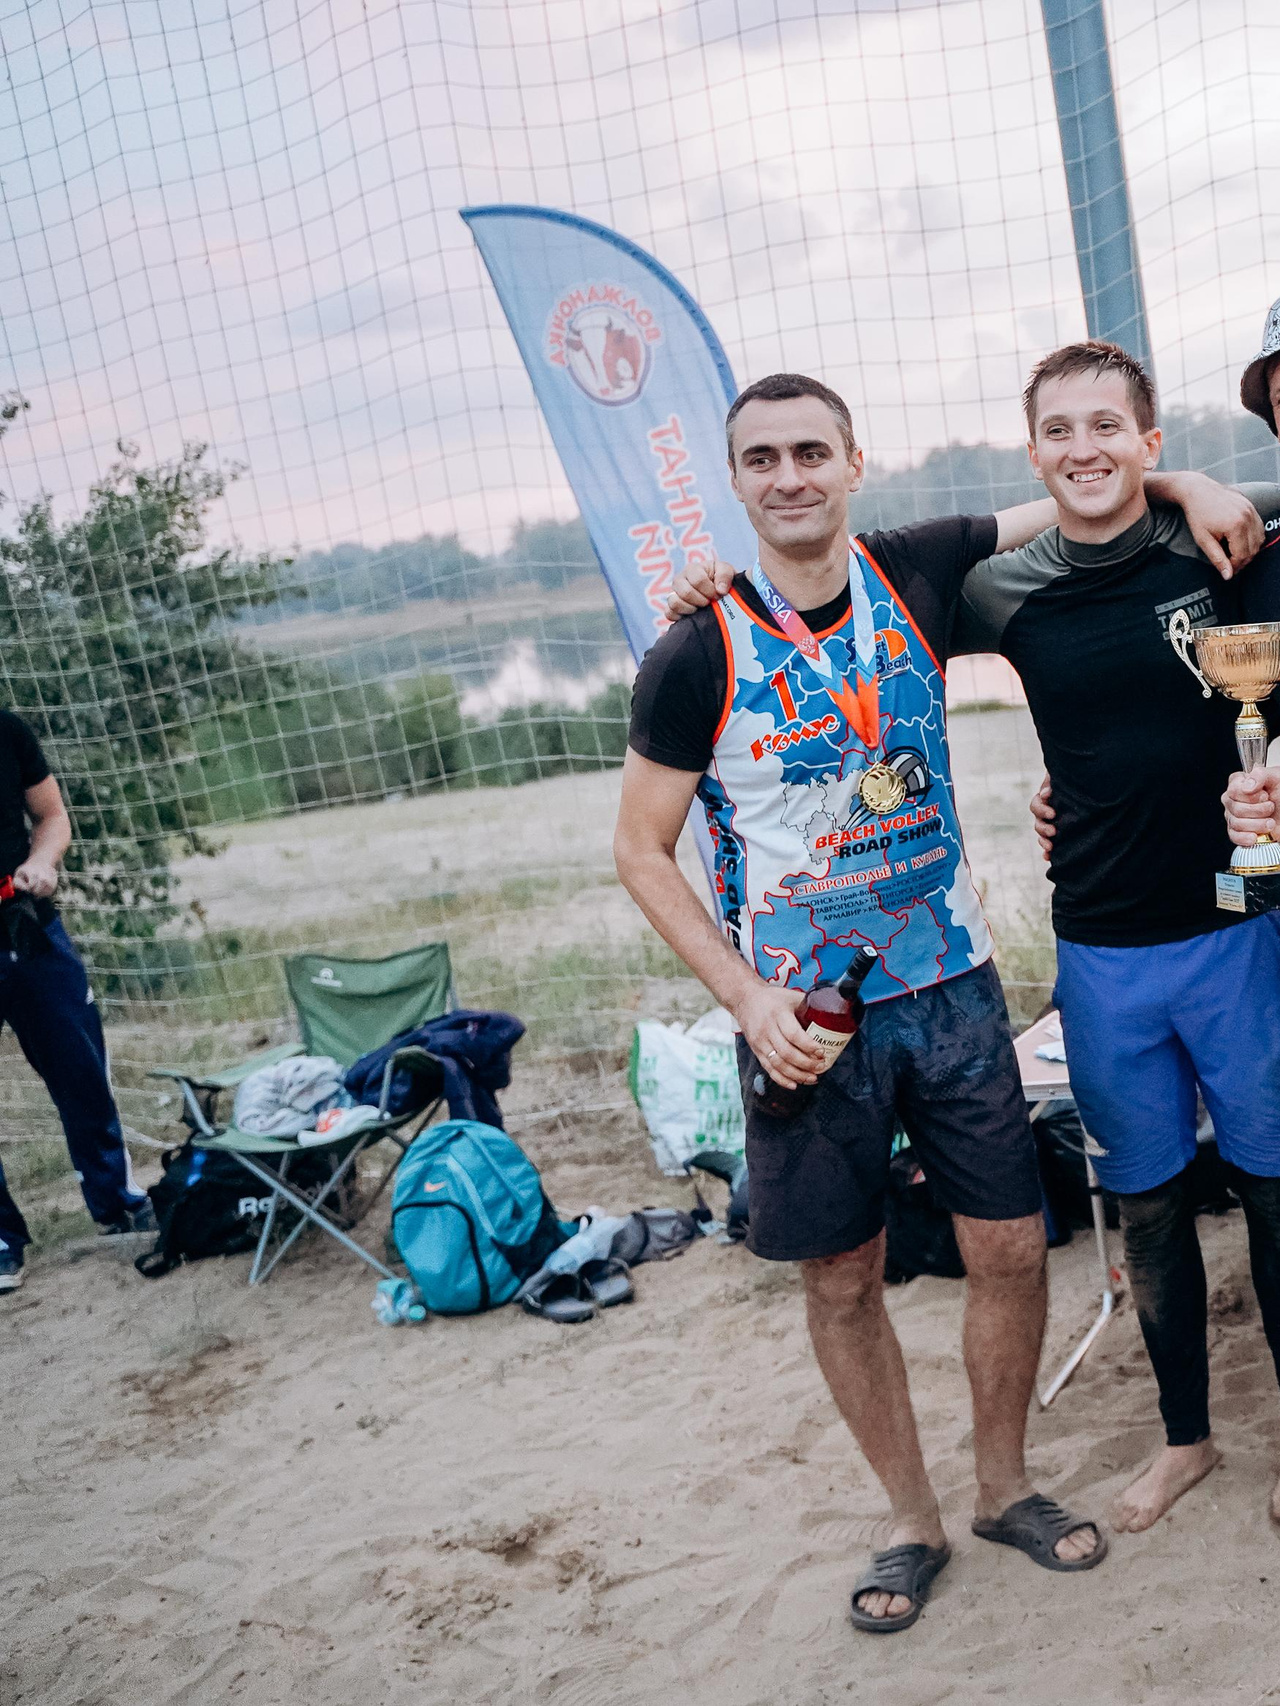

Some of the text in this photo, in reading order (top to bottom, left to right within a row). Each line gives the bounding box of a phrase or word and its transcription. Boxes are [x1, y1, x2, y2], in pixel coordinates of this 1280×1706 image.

[1157, 598, 1214, 629] TMIT
[770, 670, 798, 722] 1
[815, 803, 940, 850] BEACH VOLLEY
[838, 818, 942, 860] ROAD SHOW
[794, 864, 892, 897] СТАВРОПОЛЬЕ
[895, 860, 907, 874] И
